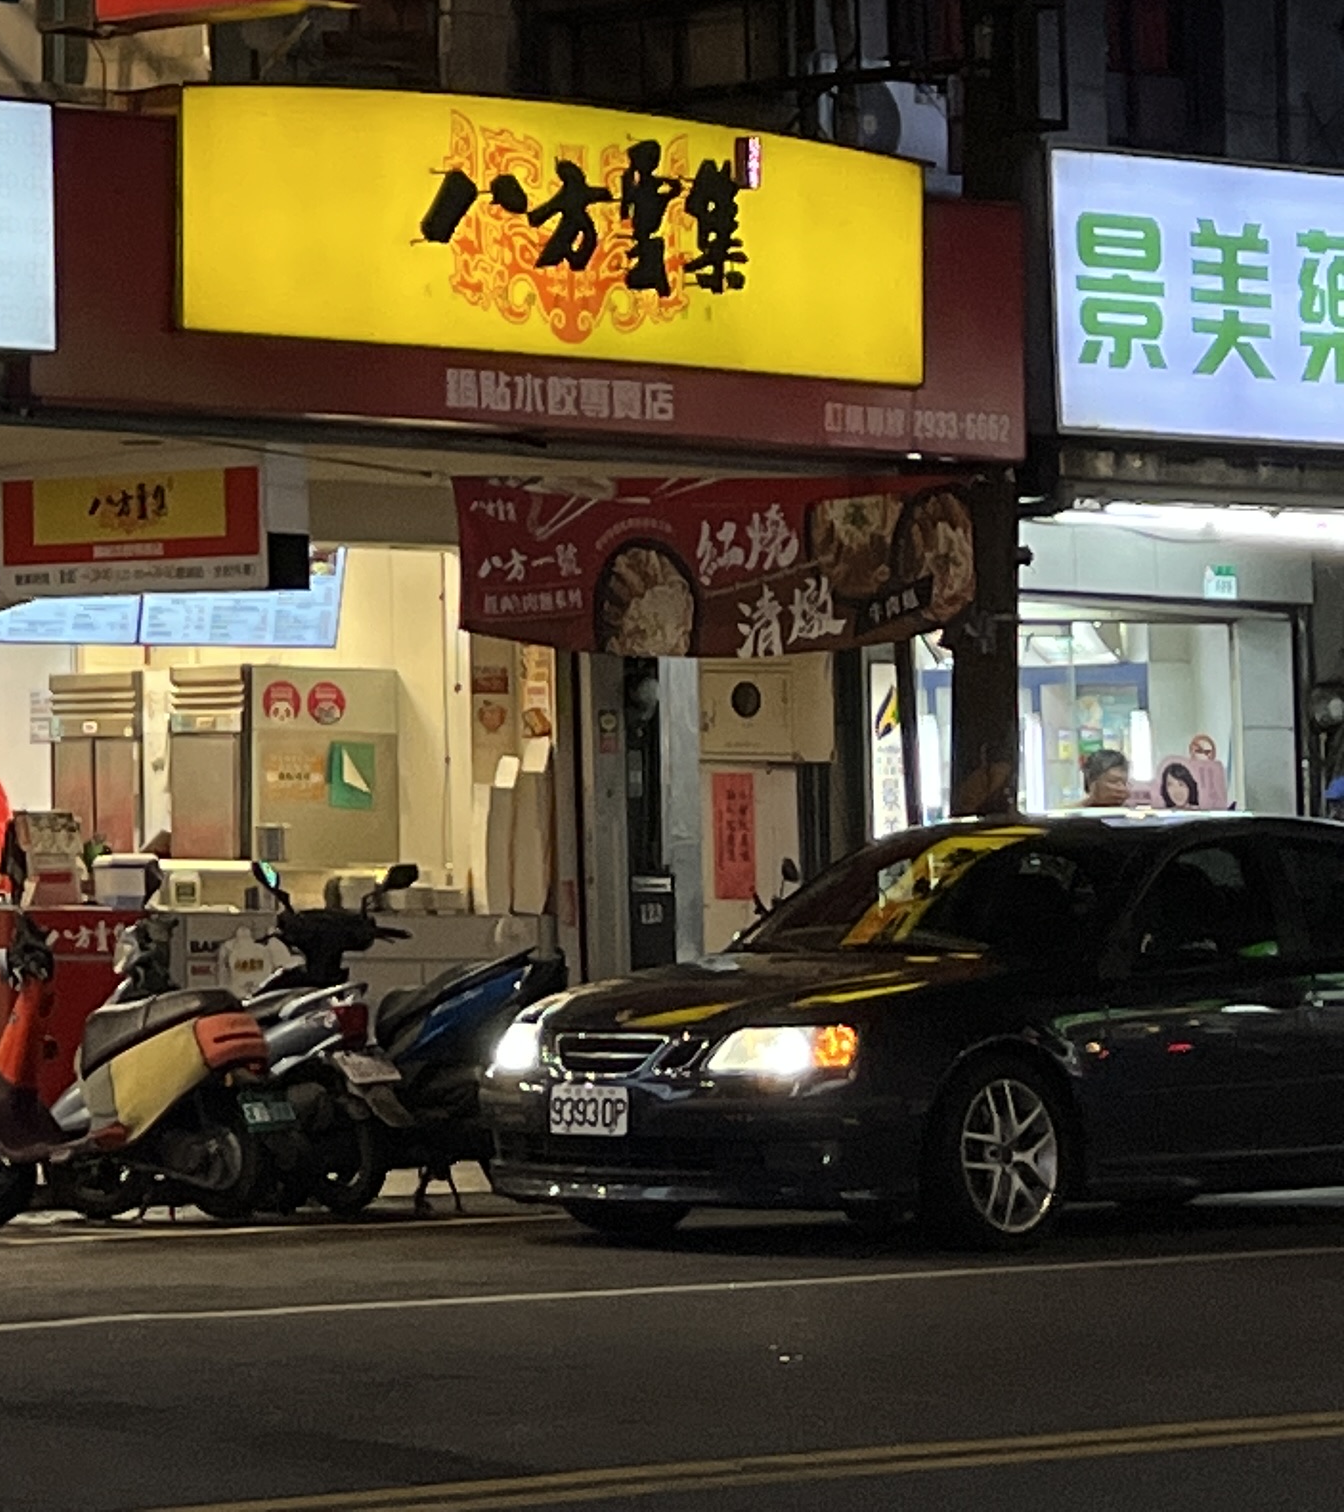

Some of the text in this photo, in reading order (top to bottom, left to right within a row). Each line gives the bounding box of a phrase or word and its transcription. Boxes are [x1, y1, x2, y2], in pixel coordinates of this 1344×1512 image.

[418, 138, 750, 295] 八方雲集
[445, 367, 674, 421] 鍋貼水餃專賣店
[696, 502, 800, 586] 紅燒
